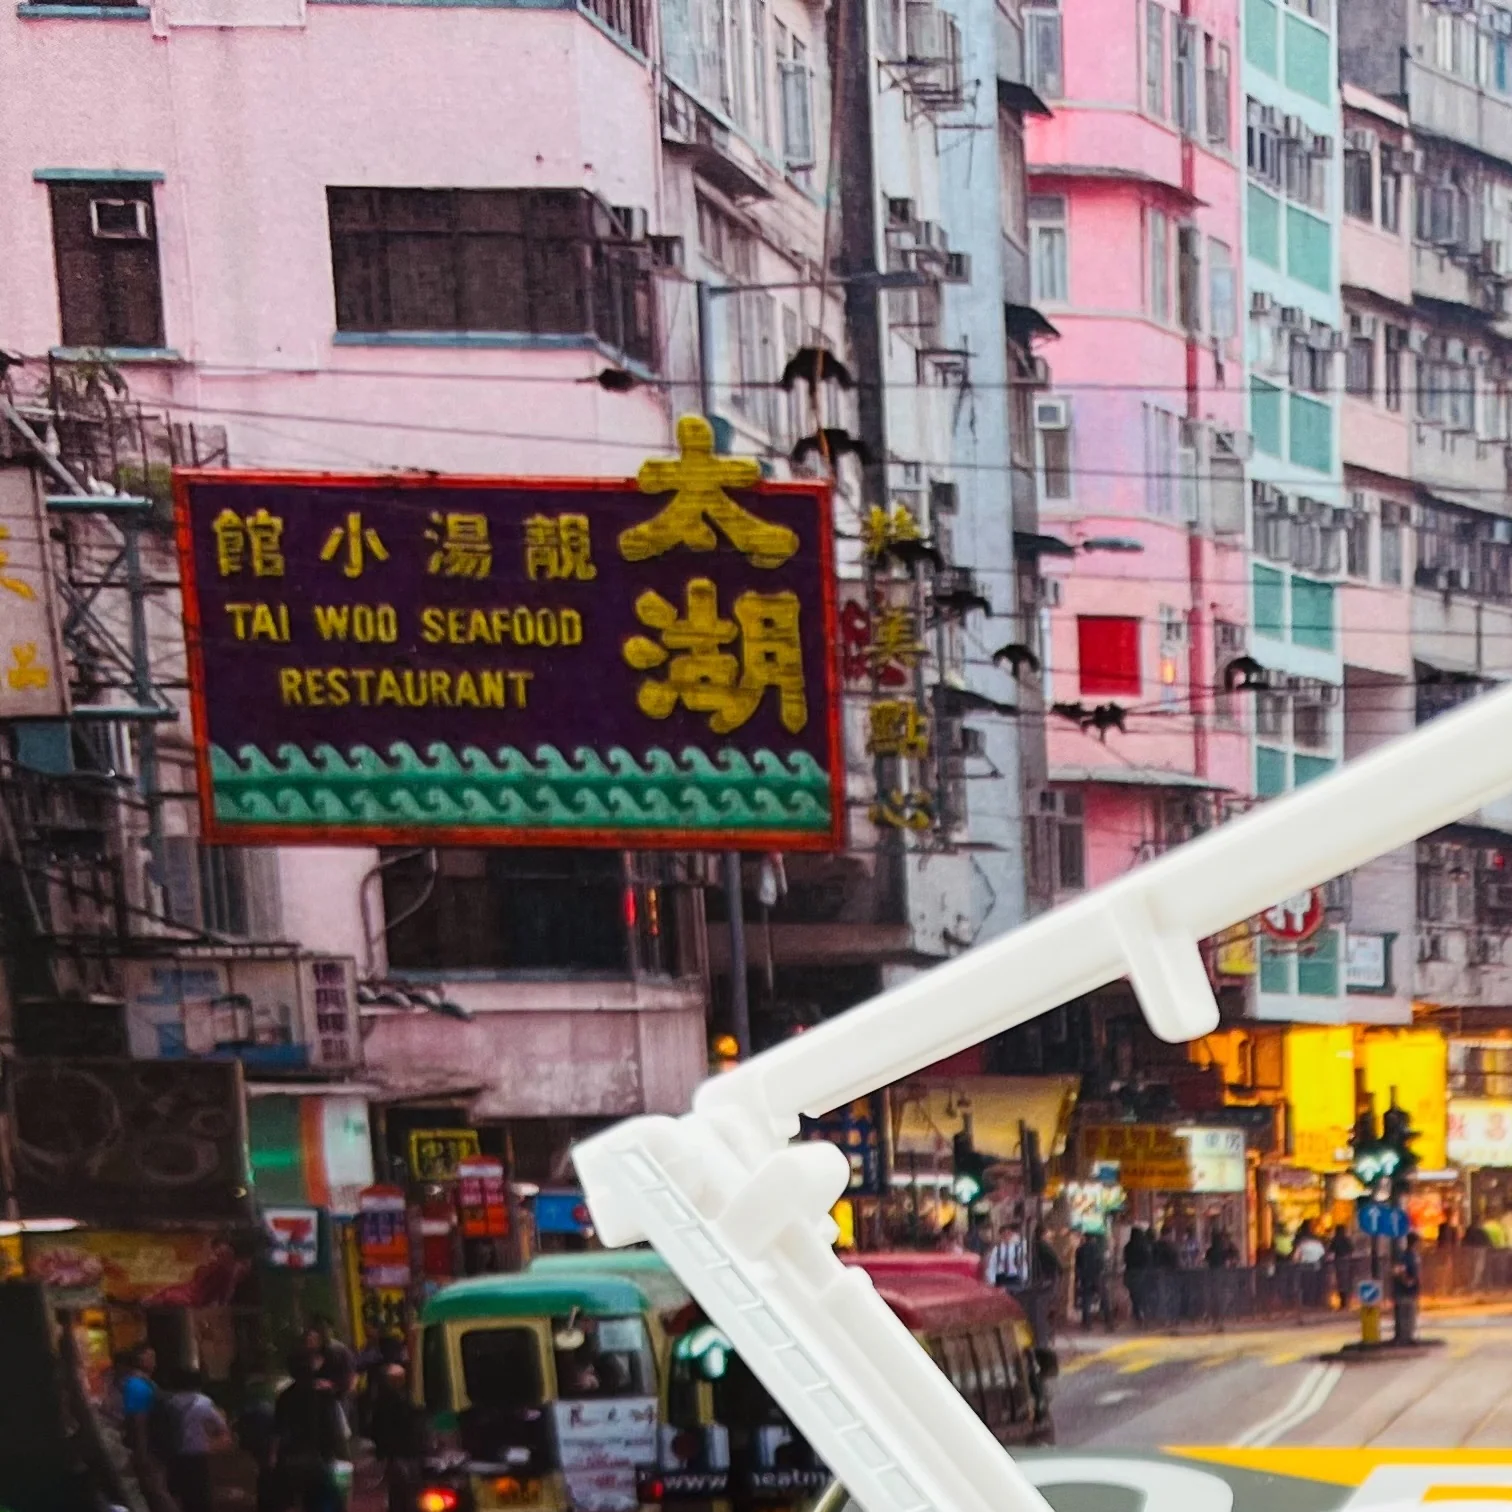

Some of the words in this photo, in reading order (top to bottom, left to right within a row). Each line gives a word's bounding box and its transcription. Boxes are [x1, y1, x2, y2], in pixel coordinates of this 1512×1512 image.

[226, 602, 290, 642] TAI
[316, 604, 398, 644] WOO
[422, 606, 583, 646] SEAFOOD
[281, 668, 533, 708] RESTAURANT
